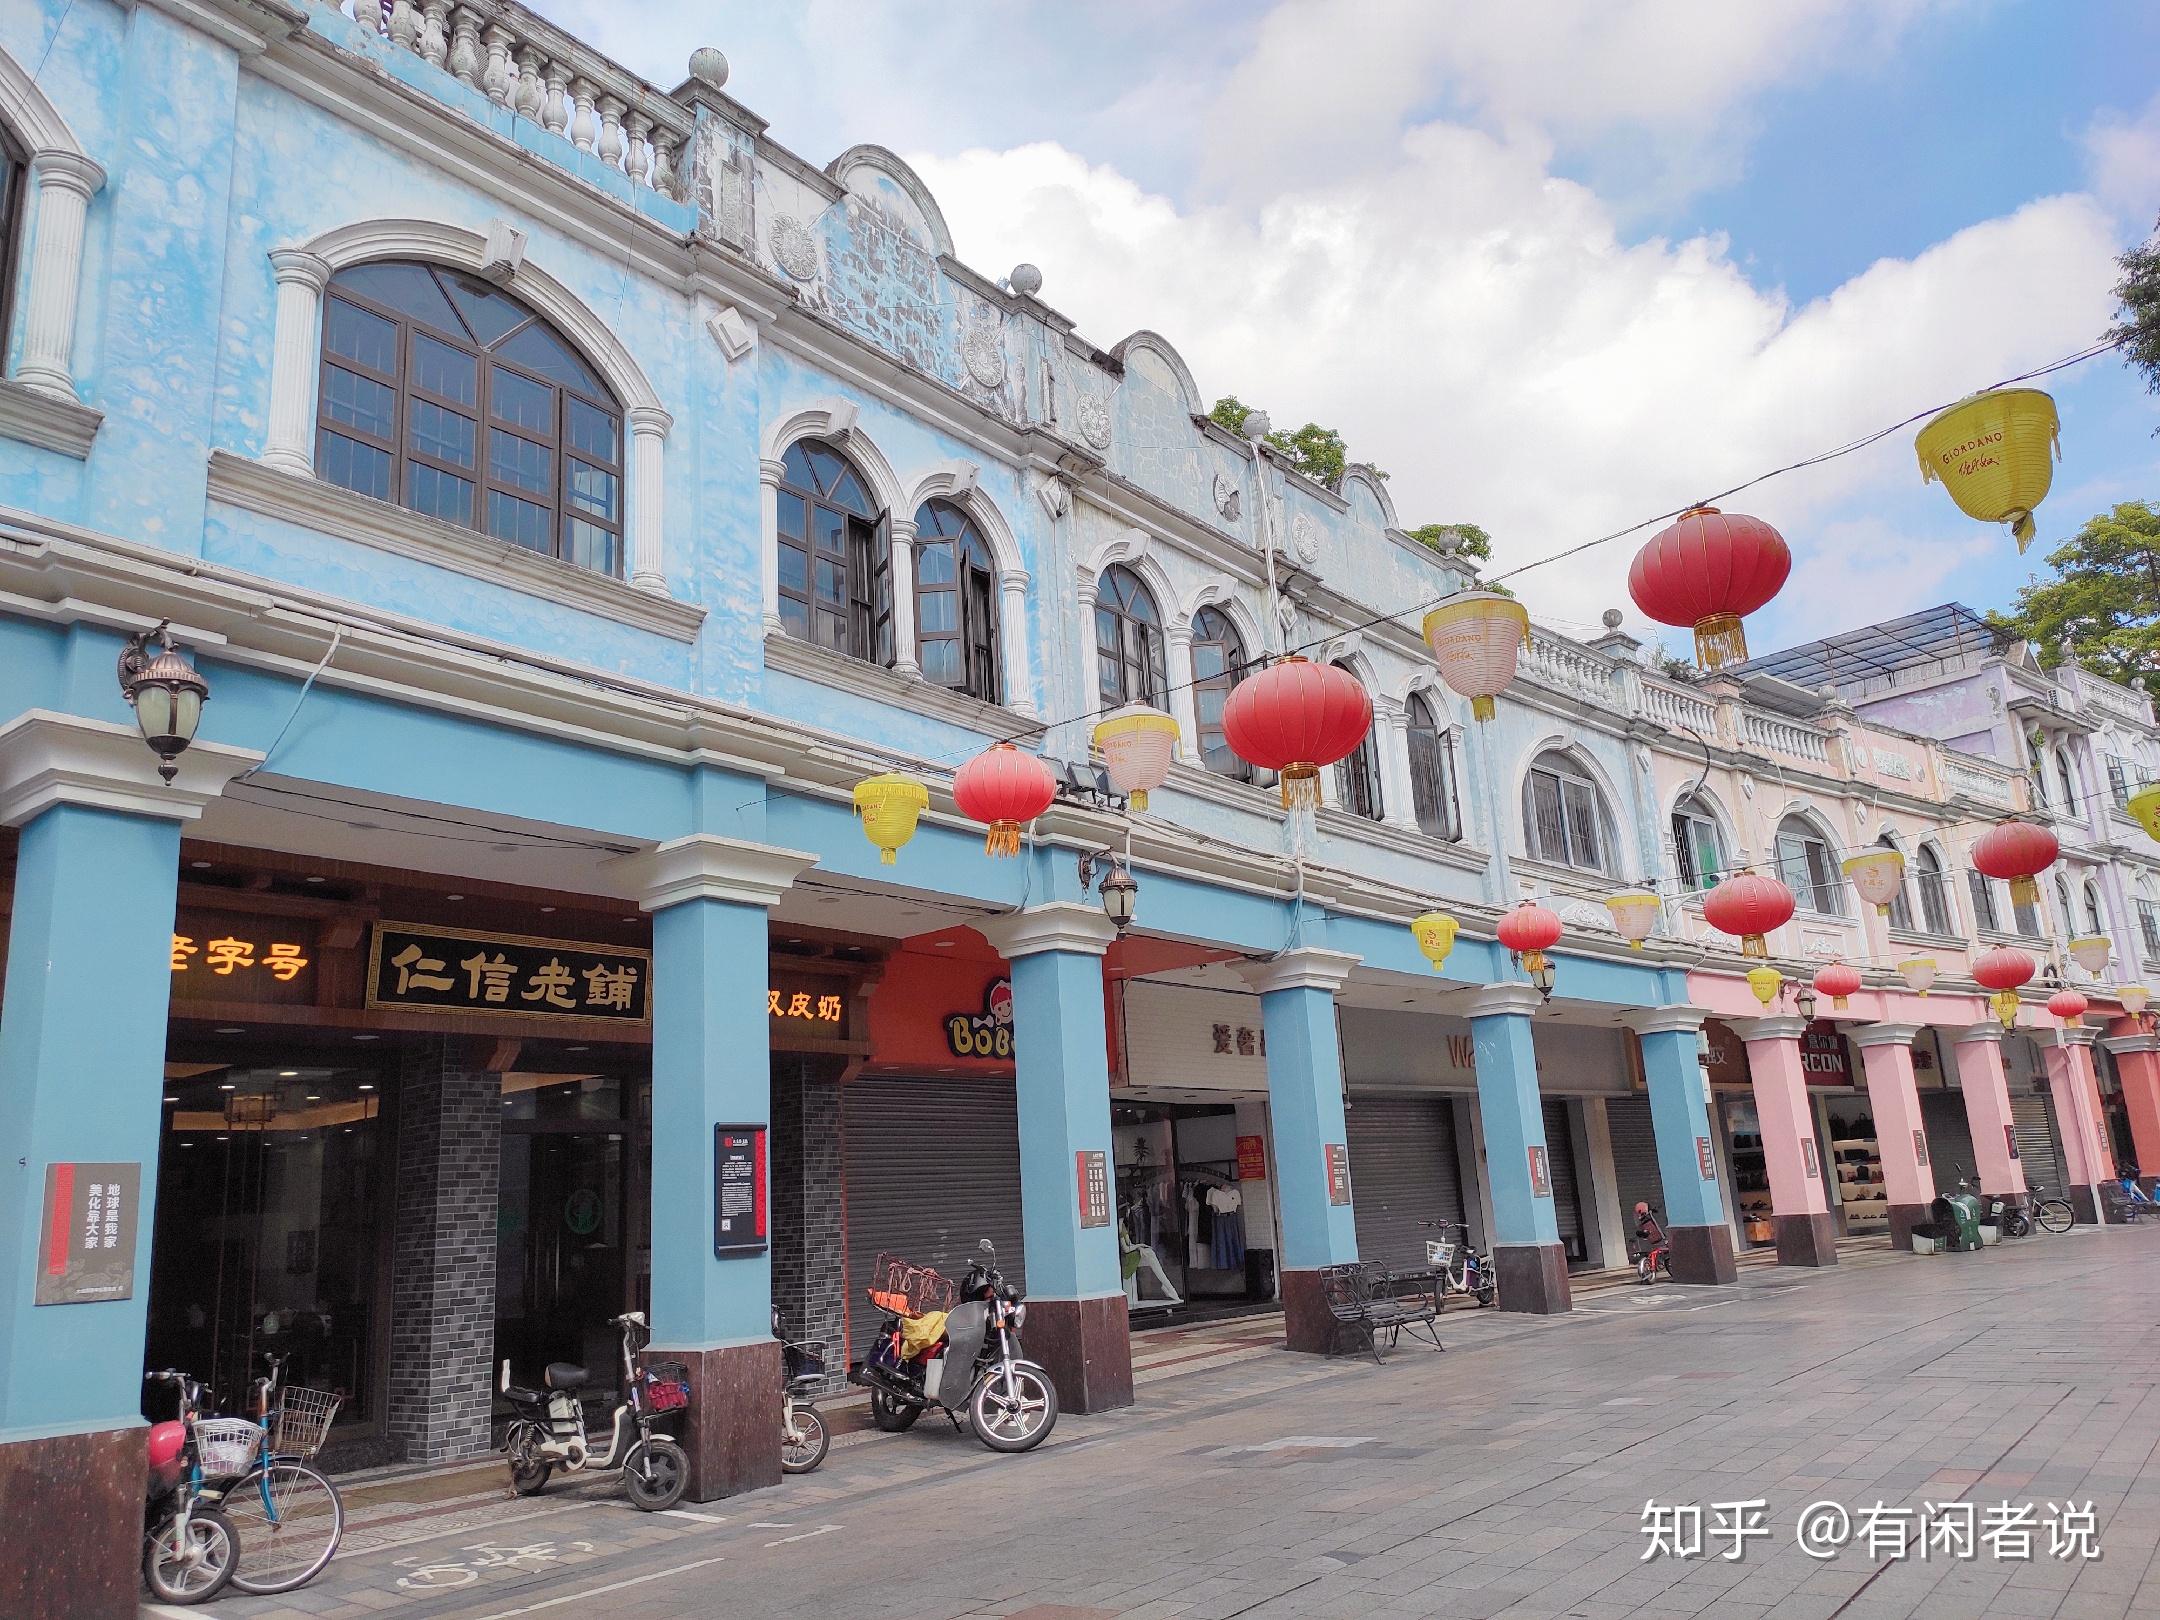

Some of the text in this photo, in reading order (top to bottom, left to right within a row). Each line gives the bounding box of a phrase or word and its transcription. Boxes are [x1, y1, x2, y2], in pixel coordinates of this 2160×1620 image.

[1942, 432, 2002, 464] GIORDANO
[768, 991, 841, 1021] 双皮奶
[84, 1183, 103, 1250] 美化靠大家
[104, 1183, 121, 1249] 地球是我家
